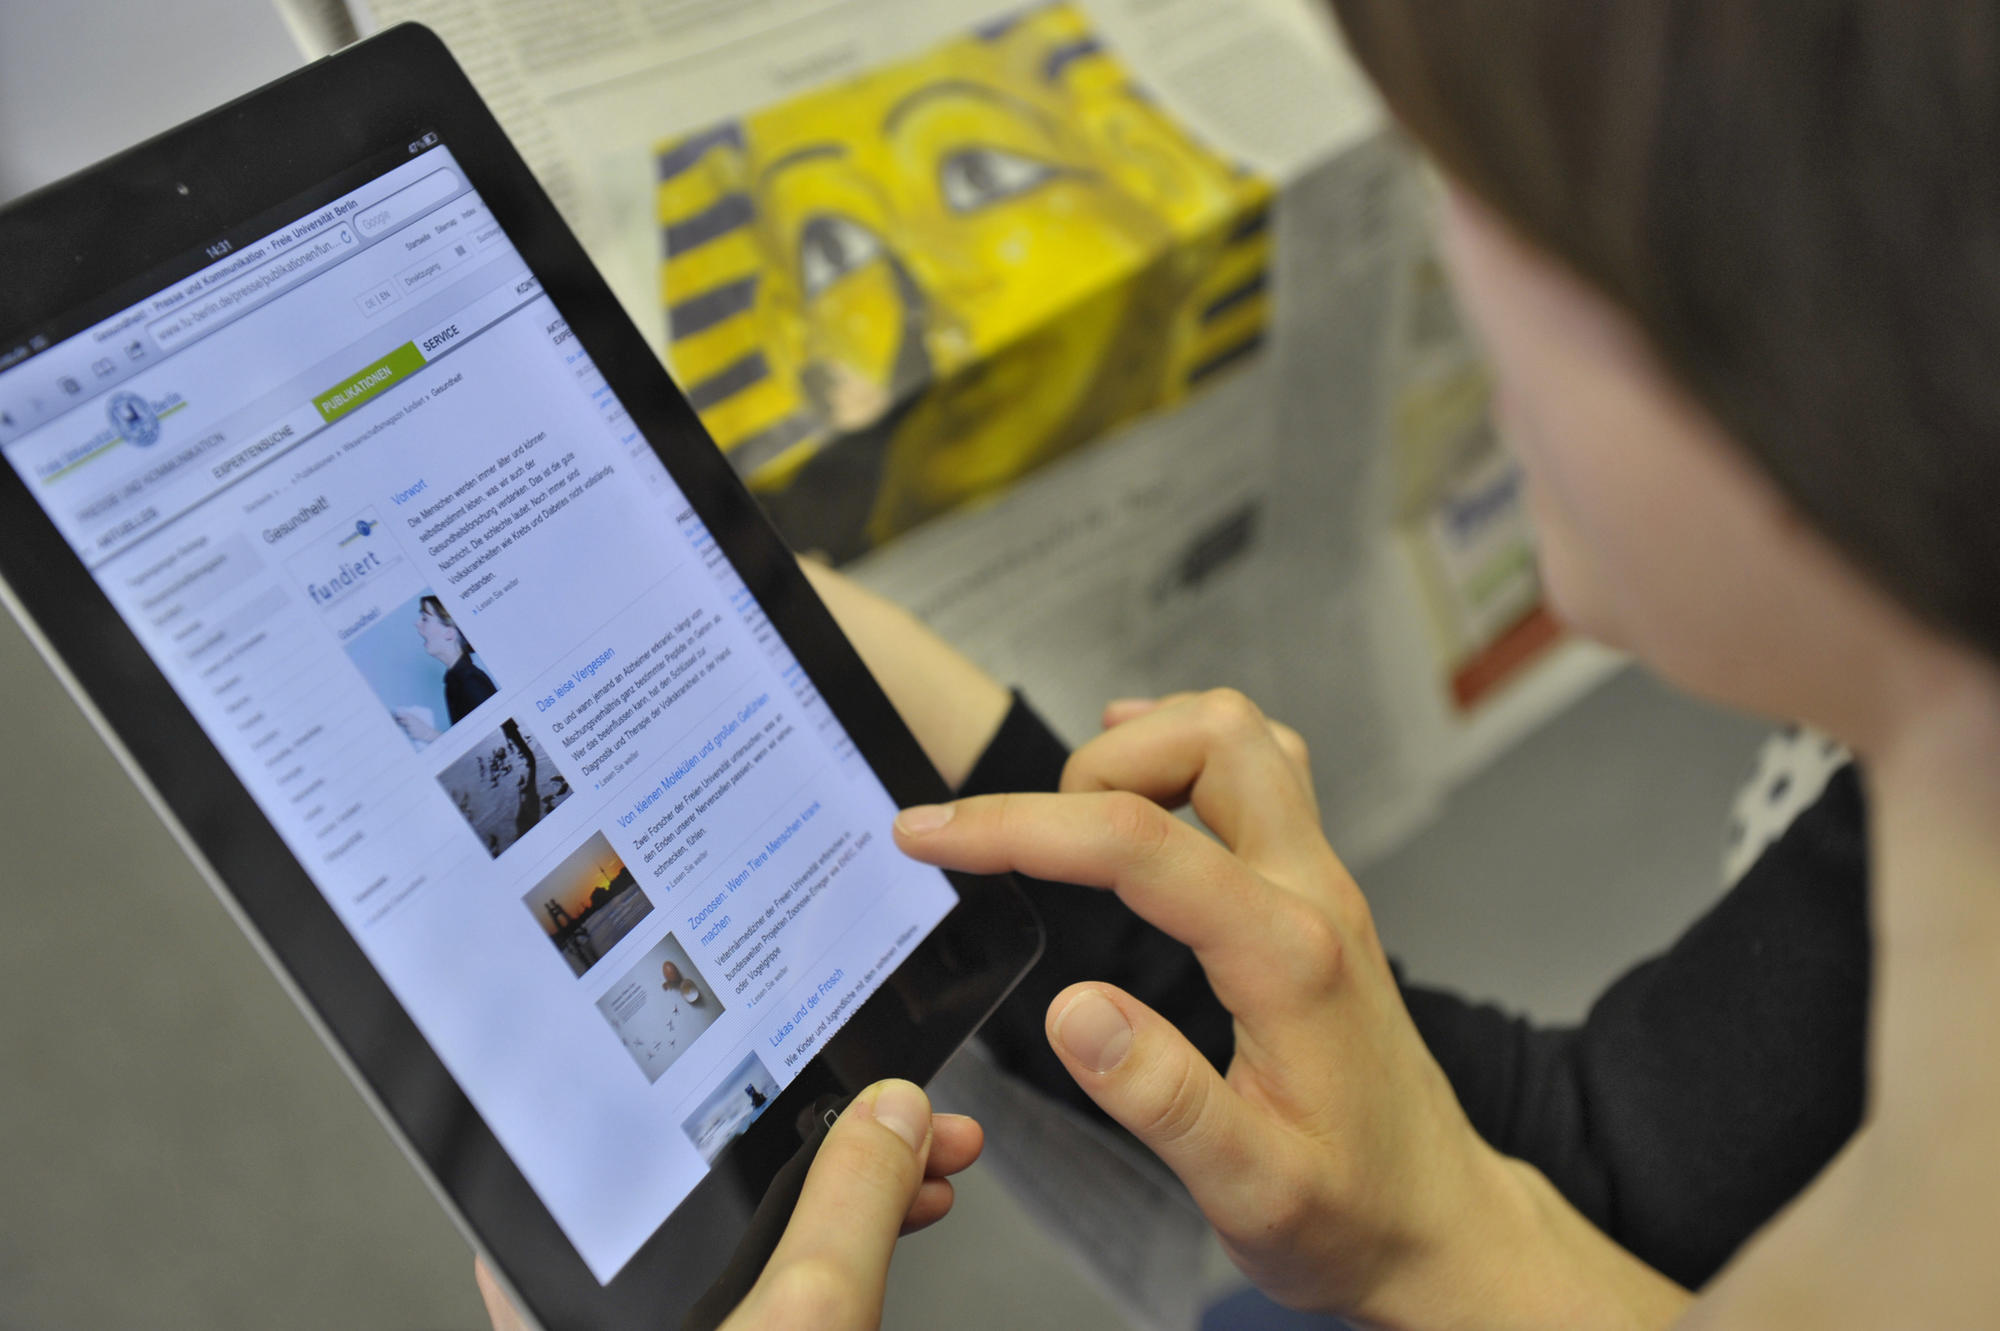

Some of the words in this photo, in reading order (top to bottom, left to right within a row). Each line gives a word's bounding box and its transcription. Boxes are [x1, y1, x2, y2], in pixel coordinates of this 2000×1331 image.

[183, 280, 203, 296] und
[201, 248, 266, 286] Kommunikation
[269, 234, 293, 250] Freie
[291, 210, 335, 238] Universität
[333, 199, 358, 217] Berlin
[205, 239, 232, 258] 14:31
[378, 289, 391, 301] EN
[422, 324, 460, 352] SERVICE
[321, 365, 392, 413] PUBLIKATIONEN
[211, 424, 294, 479] EXPERTENSUCHE
[406, 515, 422, 528] Die
[419, 493, 455, 519] Menschen
[453, 477, 478, 497] werden
[475, 463, 497, 482] immer
[495, 453, 511, 468] älter
[510, 444, 525, 458] und
[522, 430, 546, 450] können
[262, 495, 329, 544] Gesundheit!
[390, 477, 428, 505] Vorwort
[418, 505, 467, 543] selbstbestimmt
[484, 484, 499, 497] was
[498, 477, 509, 488] wir
[508, 465, 526, 481] auch
[523, 458, 536, 471] der
[427, 506, 498, 556] Gesundheitsforschung
[527, 473, 544, 487] Das
[541, 467, 552, 478] ist
[549, 460, 562, 472] die
[560, 451, 575, 467] gute
[469, 536, 484, 549] Die
[482, 516, 513, 541] schlechte
[529, 491, 548, 507] Noch
[546, 477, 567, 495] immer
[565, 467, 581, 482] sind
[307, 550, 380, 604] fundiert
[447, 544, 502, 584] Volkskrankheiten
[500, 536, 513, 549] wie
[510, 523, 532, 541] Krebs
[529, 513, 544, 528] und
[540, 496, 569, 519] Diabetes
[535, 694, 556, 713] Das
[553, 679, 575, 699] leise
[571, 647, 615, 682] Vergessen
[551, 721, 565, 734] Ob
[562, 709, 577, 725] und
[575, 697, 594, 715] wann
[591, 678, 616, 703] jemand
[613, 673, 624, 684] an
[621, 649, 651, 677] Alzheimer
[561, 697, 621, 748] Mischungsverhältnis
[619, 685, 636, 703] ganz
[633, 659, 666, 689] bestimmter
[570, 746, 587, 762] Wer
[584, 737, 599, 751] das
[595, 707, 634, 741] beeinflussen
[647, 684, 660, 698] hat
[658, 675, 672, 690] den
[580, 746, 614, 776] Diagnostik
[612, 735, 626, 751] und
[623, 715, 652, 740] Therapie
[649, 705, 662, 719] der
[704, 660, 716, 672] der
[616, 810, 637, 828] Von
[633, 786, 664, 814] kleinen
[660, 754, 700, 791] Molekülen
[697, 739, 715, 759] und
[632, 831, 650, 850] Zwei
[647, 810, 674, 837] Forscher
[673, 800, 685, 814] der
[682, 784, 703, 805] Freien
[700, 758, 731, 789] Universität
[642, 849, 657, 864] den
[653, 831, 676, 853] Enden
[673, 812, 696, 835] unserer
[694, 780, 732, 816] Nervenzellen
[724, 868, 750, 893] Wenn
[746, 851, 769, 872] Tiere
[764, 818, 802, 855] Menschen
[699, 914, 731, 947] machen
[714, 915, 766, 966] Veterinärmediziner
[764, 904, 776, 919] der
[773, 888, 793, 909] Freien
[724, 941, 764, 982] bundesweiten
[760, 916, 789, 944] Projekten
[734, 977, 749, 995] oder
[747, 946, 781, 980] Vogelgrippe
[768, 1020, 794, 1047] Lukas
[791, 1003, 808, 1024] und
[806, 991, 820, 1009] der
[817, 967, 844, 996] Frosch
[784, 1052, 798, 1067] Wie
[795, 1032, 816, 1055] Kinder
[813, 1020, 827, 1037] und
[824, 990, 856, 1025] Jugendliche
